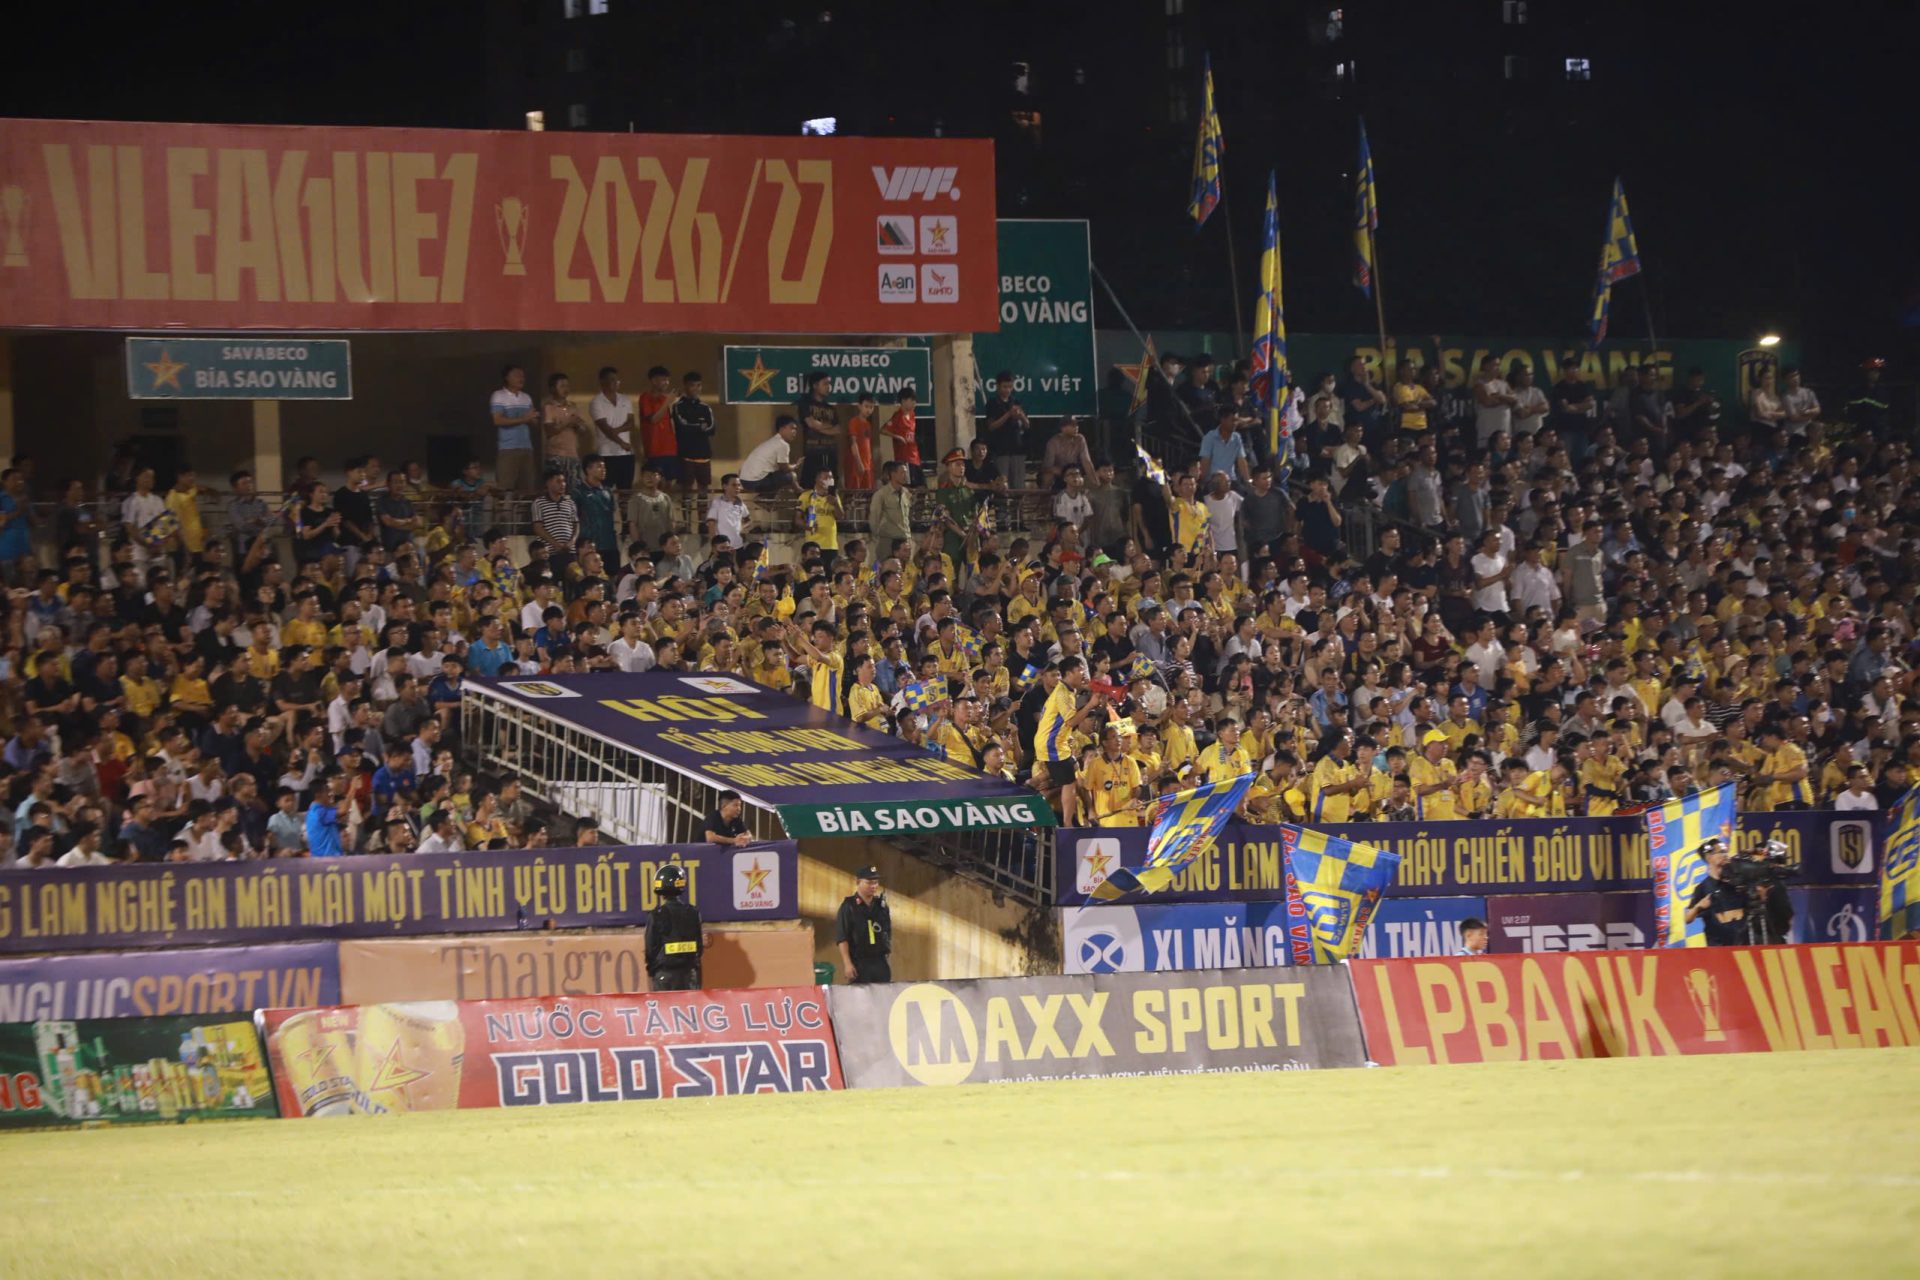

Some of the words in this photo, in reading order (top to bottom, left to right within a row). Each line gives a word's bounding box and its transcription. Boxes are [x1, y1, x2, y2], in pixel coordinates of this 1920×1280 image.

[550, 155, 834, 304] 2026/27
[998, 275, 1050, 293] BECO
[1022, 297, 1088, 324] VÀNG
[222, 346, 308, 360] SAVABECO
[811, 354, 890, 367] SAVABECO
[234, 370, 275, 388] SAO
[279, 367, 337, 388] VÀNG
[828, 376, 860, 394] AO
[1040, 373, 1083, 395] VIỆT
[597, 695, 769, 722] HỘI
[874, 807, 941, 831] SAO
[940, 802, 1036, 827] VÀNG
[1228, 842, 1280, 890] LAM
[1398, 831, 1447, 886] HÃY
[1454, 826, 1526, 885] CHIẾN
[1532, 825, 1583, 882] ĐẤU
[1589, 827, 1614, 881] VÌ
[20, 882, 88, 937] LAM
[96, 870, 177, 939] NGHỆ
[185, 877, 228, 930] AN
[235, 866, 292, 928] MÃI
[301, 864, 355, 924] MÃI
[363, 862, 424, 928] MỘT
[435, 859, 504, 920] TÌNH
[513, 856, 567, 916] YÊU
[576, 851, 630, 914] BẤT
[1152, 929, 1184, 971] XI
[1193, 916, 1285, 969] MĂNG
[485, 1003, 604, 1043] NƯỚC
[616, 1001, 731, 1036] TĂNG
[743, 998, 823, 1037] LỰC
[906, 992, 1116, 1066] MAXX
[1132, 983, 1306, 1054] SPORT
[1373, 955, 1681, 1066] LPBANK
[491, 1046, 661, 1108] GOLD
[663, 1039, 832, 1098] STAR
